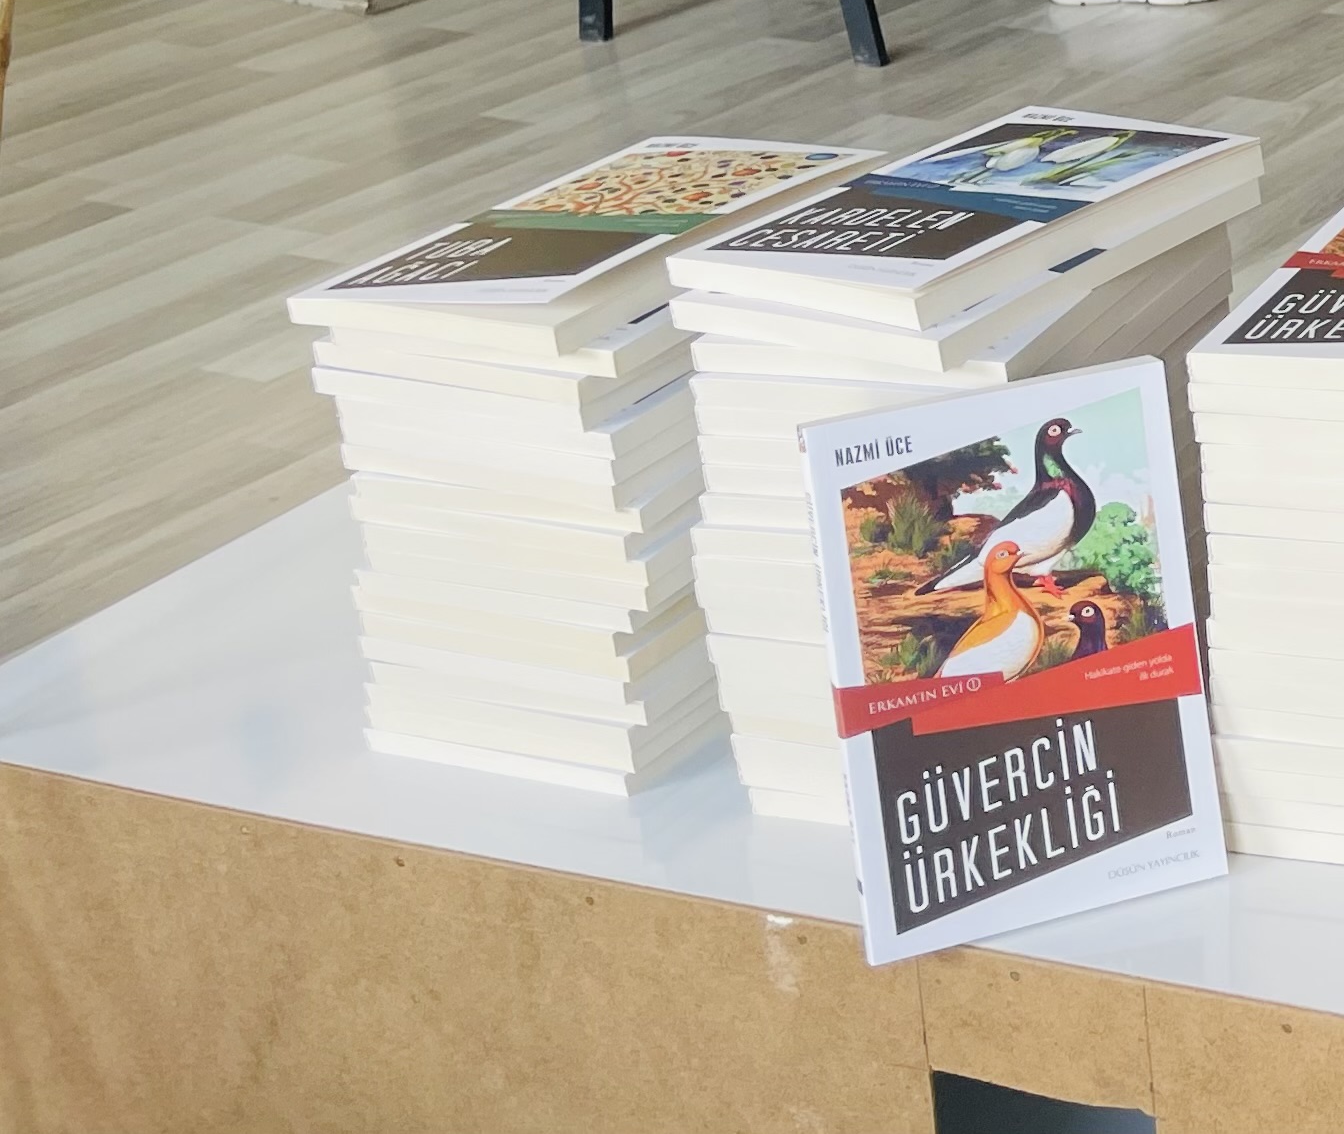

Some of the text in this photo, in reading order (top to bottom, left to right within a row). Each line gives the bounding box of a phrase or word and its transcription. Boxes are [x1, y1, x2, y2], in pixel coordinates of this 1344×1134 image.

[778, 207, 975, 230] KARDELEN
[405, 237, 513, 261] TUBA
[728, 229, 925, 252] CESARETİ
[834, 435, 913, 467] NAZMİ ÜCE
[868, 690, 938, 715] ERKAM'IN
[941, 682, 964, 699] EVİ
[897, 718, 1098, 845] GÜVERCİN
[903, 770, 1121, 914] ÜRKEKLİĞİ
[1166, 827, 1197, 839] Roman
[1147, 849, 1201, 870] YAYINCILIK
